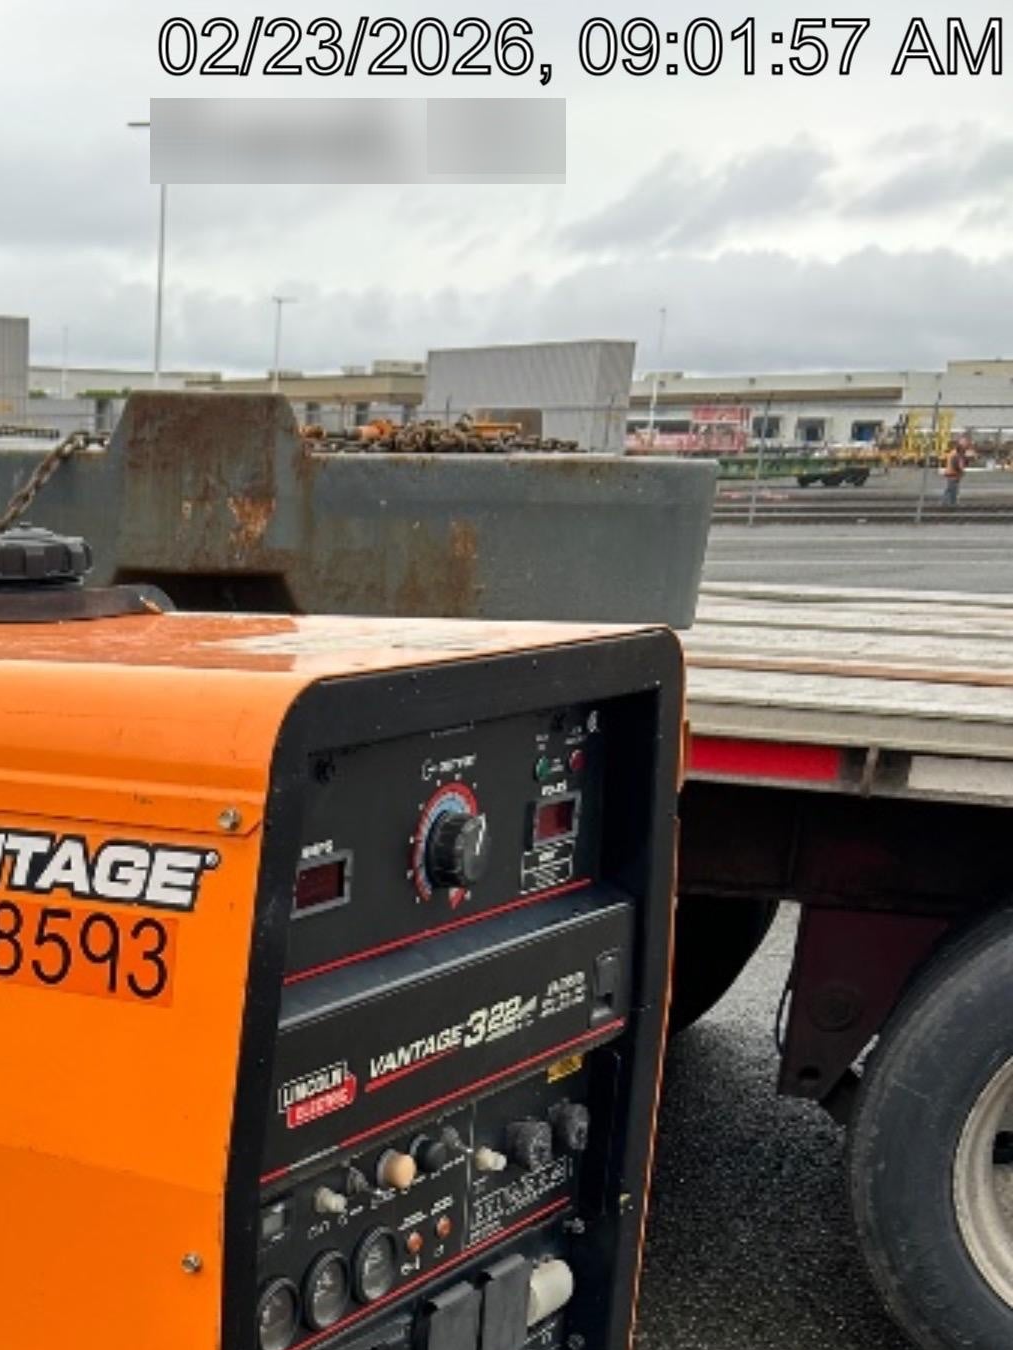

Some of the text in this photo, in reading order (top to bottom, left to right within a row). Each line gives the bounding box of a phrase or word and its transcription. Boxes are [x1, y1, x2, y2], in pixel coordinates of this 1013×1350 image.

[370, 1022, 464, 1078] VANTAGE
[463, 995, 523, 1048] 322
[284, 1066, 343, 1107] LINCOLN
